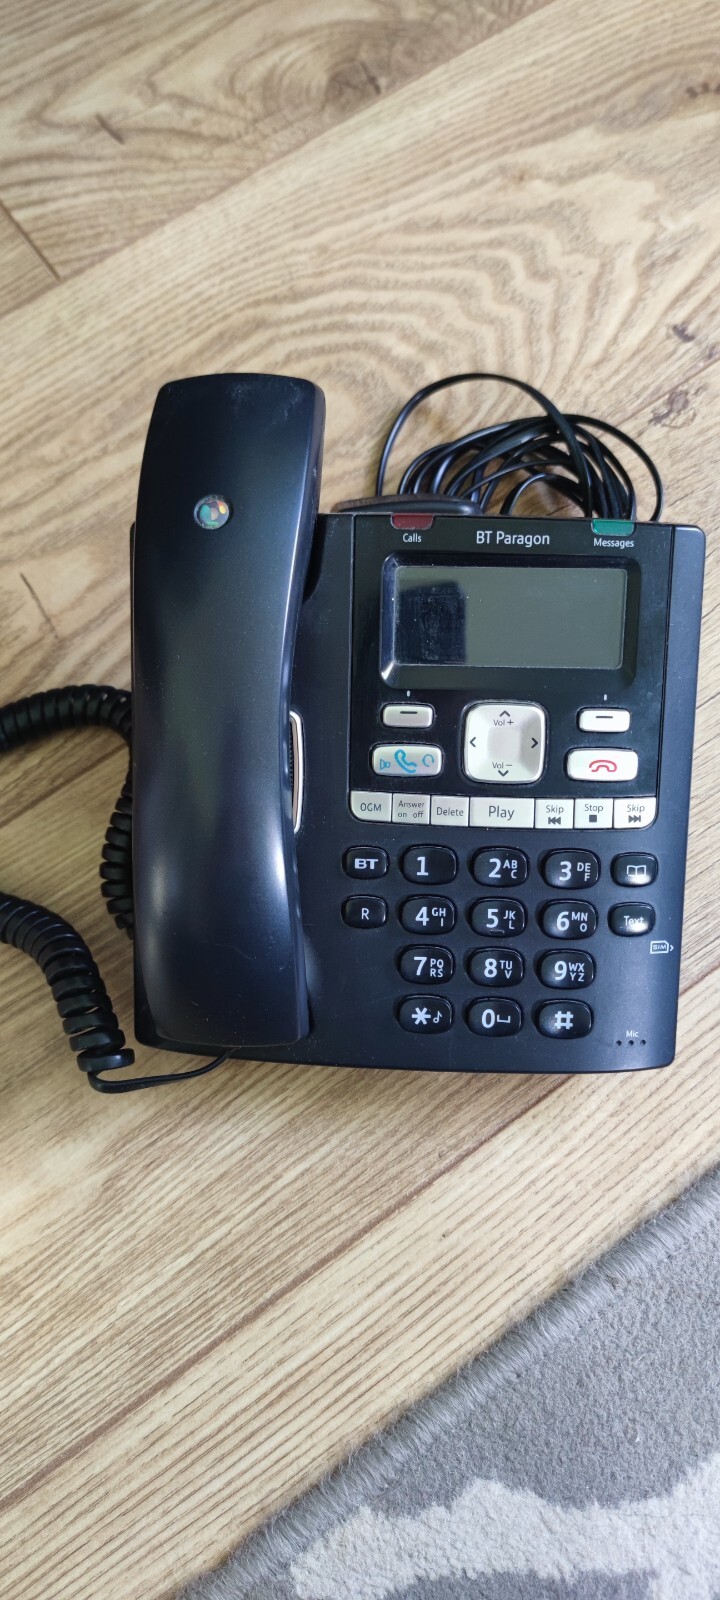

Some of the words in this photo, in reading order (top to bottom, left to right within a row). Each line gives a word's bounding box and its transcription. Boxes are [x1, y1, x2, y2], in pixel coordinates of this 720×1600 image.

[403, 534, 422, 543] Calls
[476, 531, 492, 545] BT
[496, 531, 550, 548] Paragon
[594, 538, 634, 549] Messages
[360, 803, 382, 812] OGM
[398, 800, 425, 808] Answer
[545, 805, 564, 815] Skip
[584, 804, 604, 814] Stop
[627, 804, 645, 814] Skip
[413, 810, 424, 818] off
[436, 807, 464, 816] Delete
[488, 806, 515, 820] Play
[354, 858, 379, 869] BT
[416, 856, 429, 876] 1
[489, 858, 501, 878] 2
[559, 861, 572, 881] 3
[361, 908, 369, 920] R
[415, 906, 429, 926] 4
[486, 909, 499, 928] 5
[556, 911, 569, 931] 6
[623, 915, 644, 926] Text
[414, 957, 427, 976] 7
[484, 958, 497, 978] 8
[554, 960, 567, 980] 9
[481, 1009, 495, 1028] 0
[626, 1029, 638, 1038] Mic
